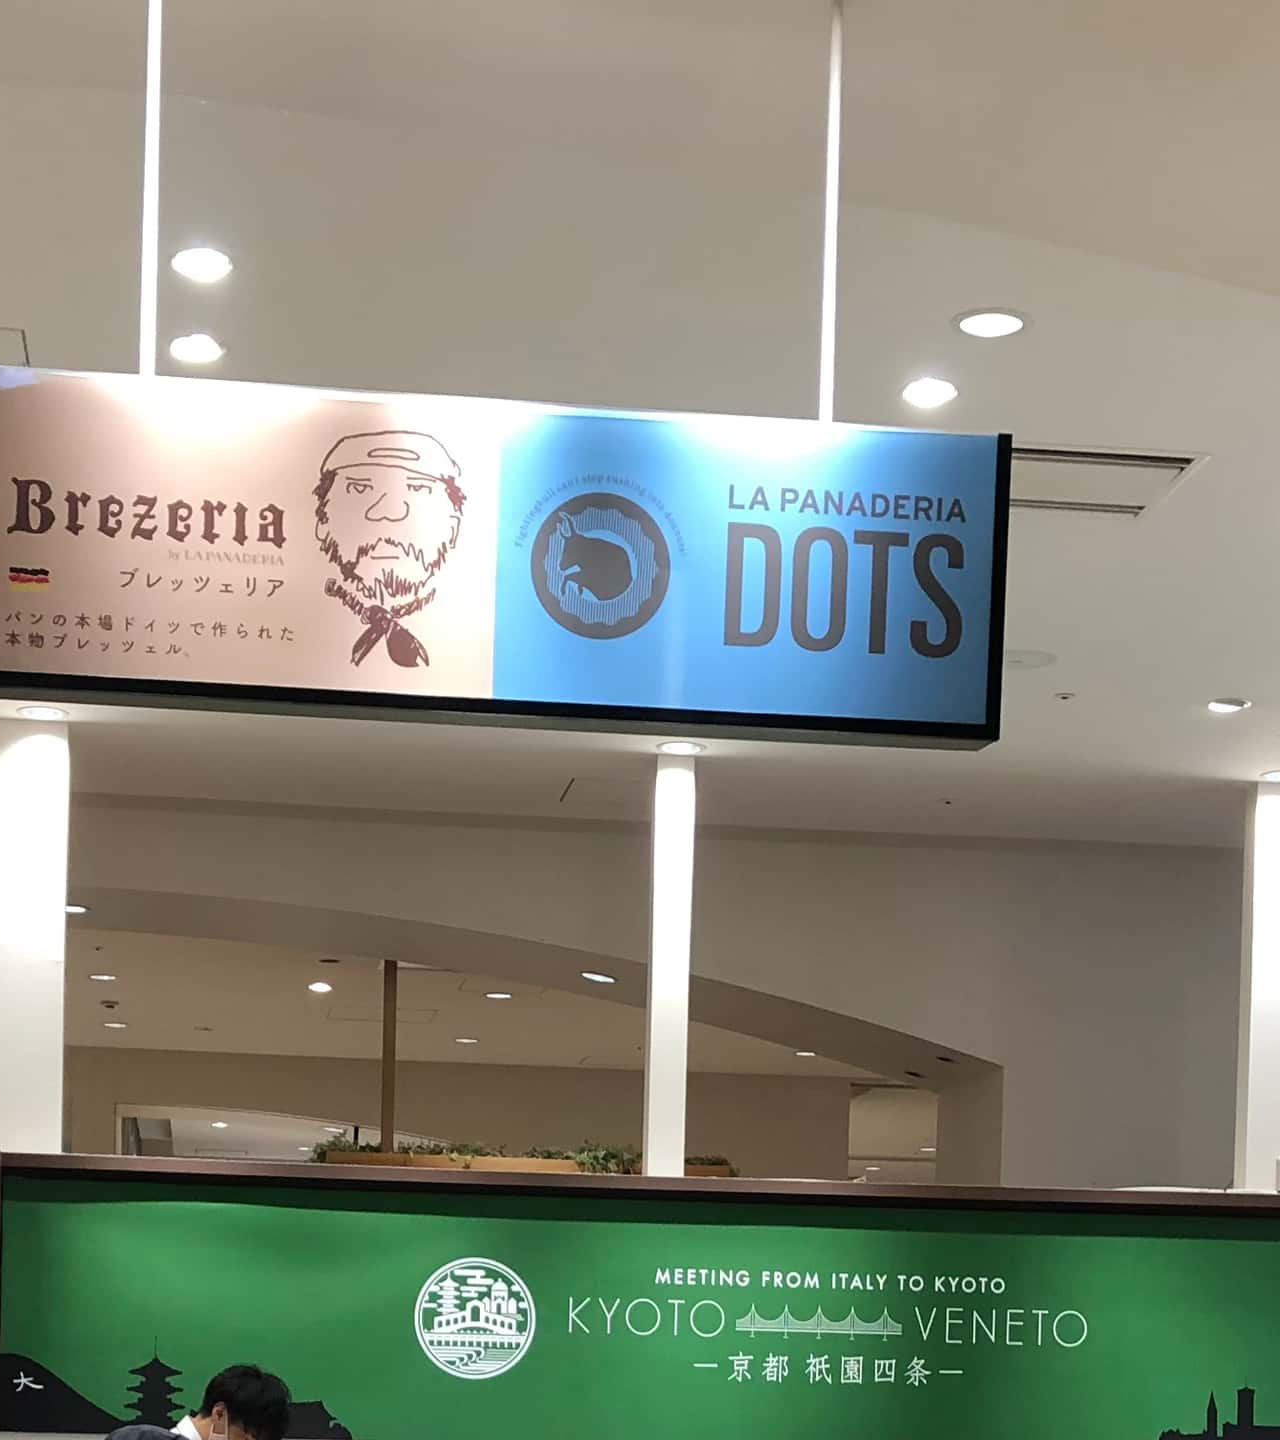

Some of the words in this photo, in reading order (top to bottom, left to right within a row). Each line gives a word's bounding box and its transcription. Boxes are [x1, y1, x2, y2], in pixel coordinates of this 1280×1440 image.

[7, 477, 287, 548] Brezeria
[728, 484, 770, 511] LA
[780, 487, 966, 523] PANADERIA
[120, 568, 285, 598] ブレッツェリア
[723, 521, 965, 658] DOTS
[5, 611, 294, 641] パンの本場ドイツで作られた
[656, 1268, 750, 1289] MEETING
[761, 1270, 820, 1290] FROM
[831, 1273, 889, 1292] ITALY
[896, 1274, 924, 1293] TO
[935, 1275, 1007, 1295] KYOTO
[569, 1296, 725, 1339] KYOTO
[917, 1306, 1088, 1348] VENETO
[728, 1351, 789, 1384] 京都
[805, 1353, 932, 1387] 祇園四条
